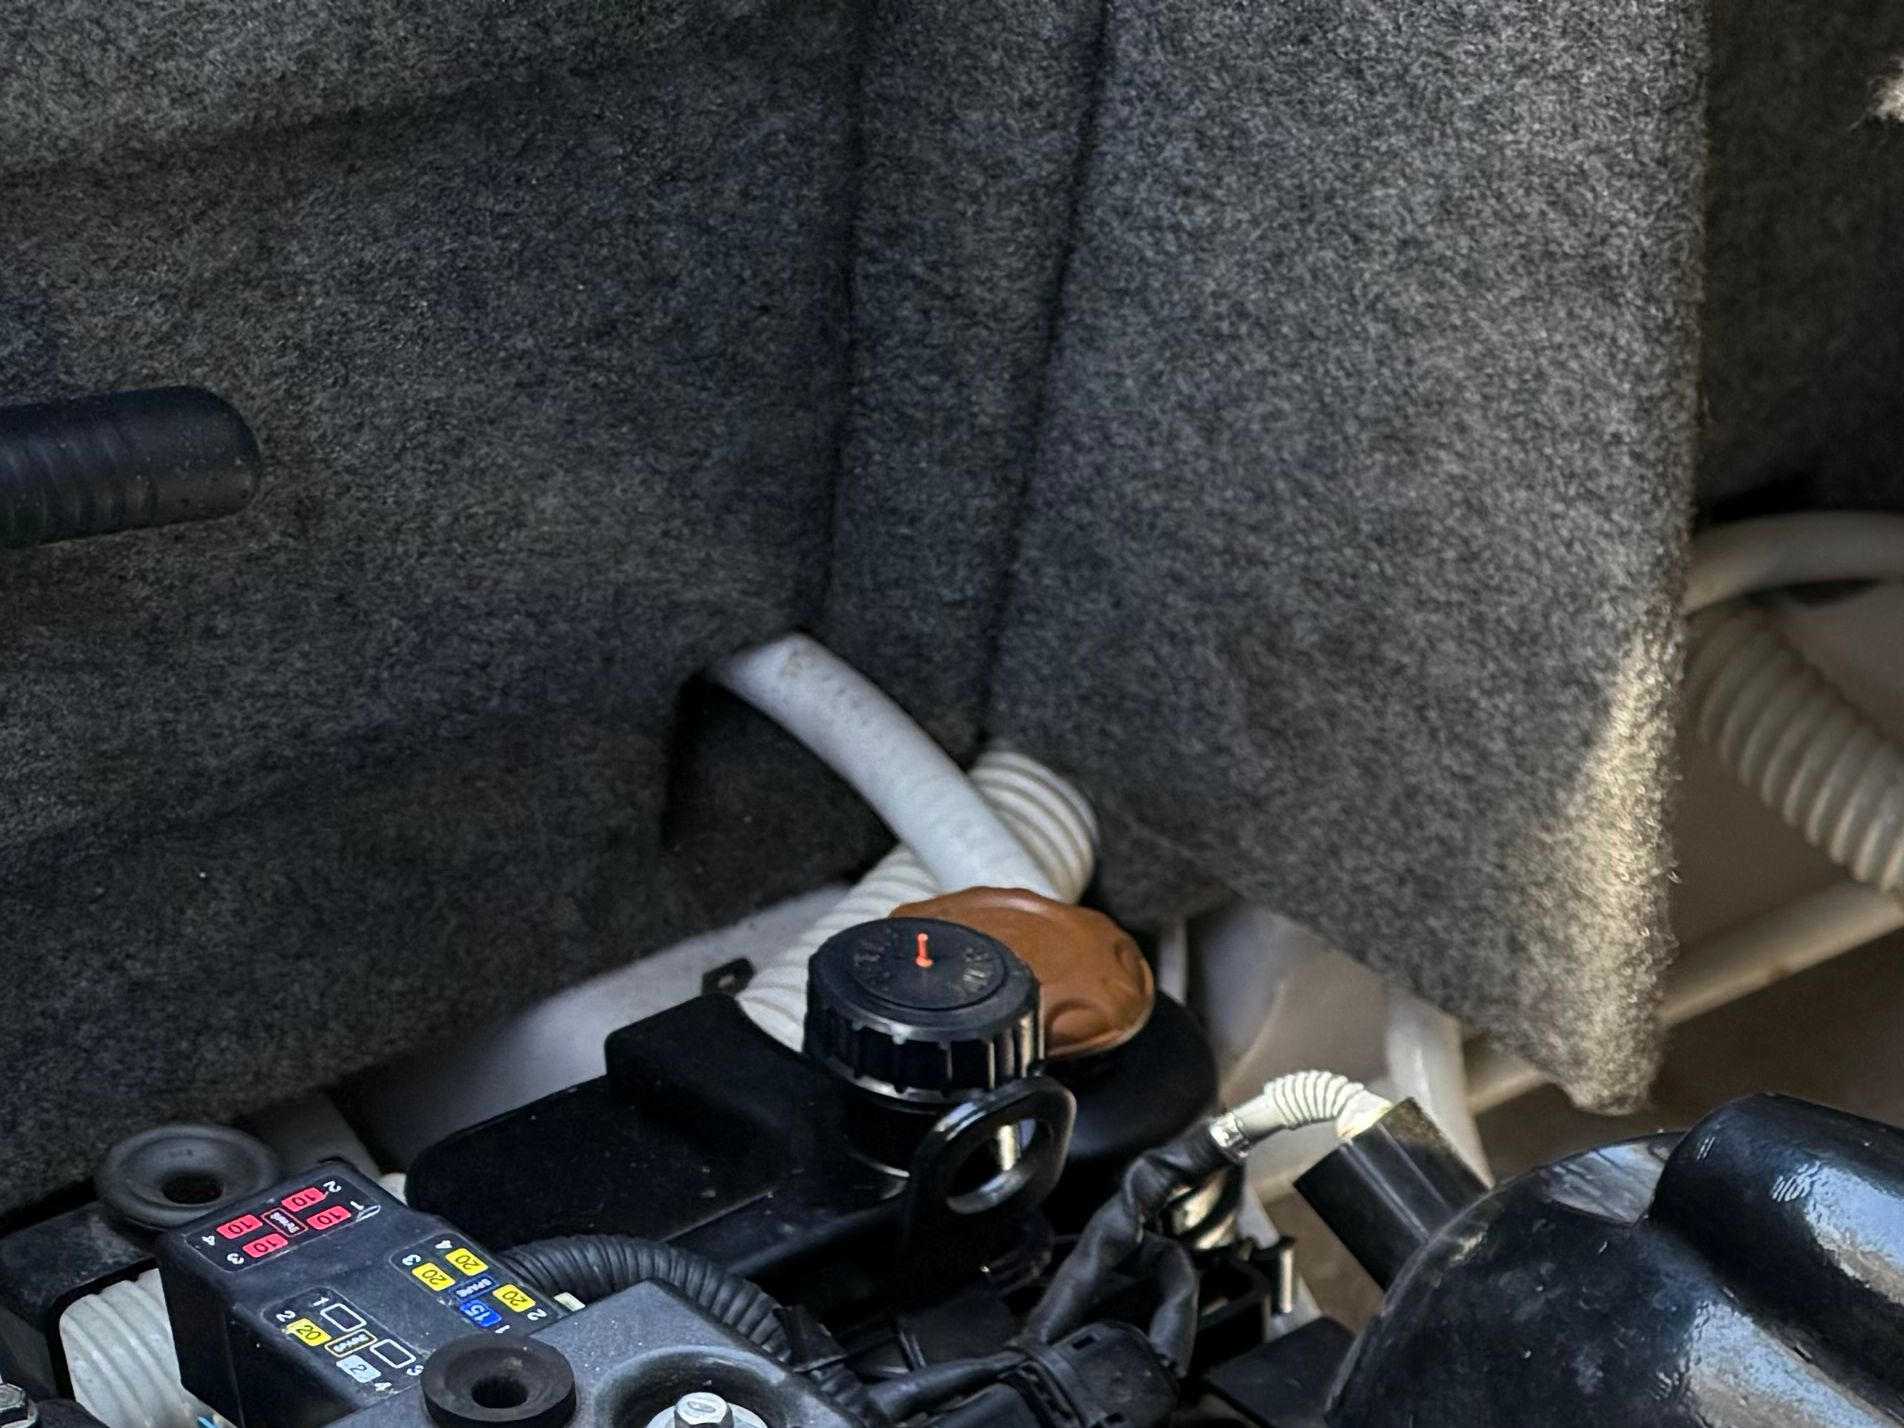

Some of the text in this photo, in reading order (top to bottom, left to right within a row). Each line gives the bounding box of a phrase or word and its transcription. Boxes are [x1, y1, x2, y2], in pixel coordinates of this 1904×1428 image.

[291, 1187, 313, 1209] 10
[228, 1216, 250, 1237] 10
[316, 1207, 338, 1228] 10
[252, 1235, 274, 1255] 10
[458, 1250, 480, 1272] 20
[423, 1265, 445, 1287] 20
[504, 1286, 526, 1308] 20
[468, 1301, 490, 1323] 15
[298, 1321, 322, 1345] 20
